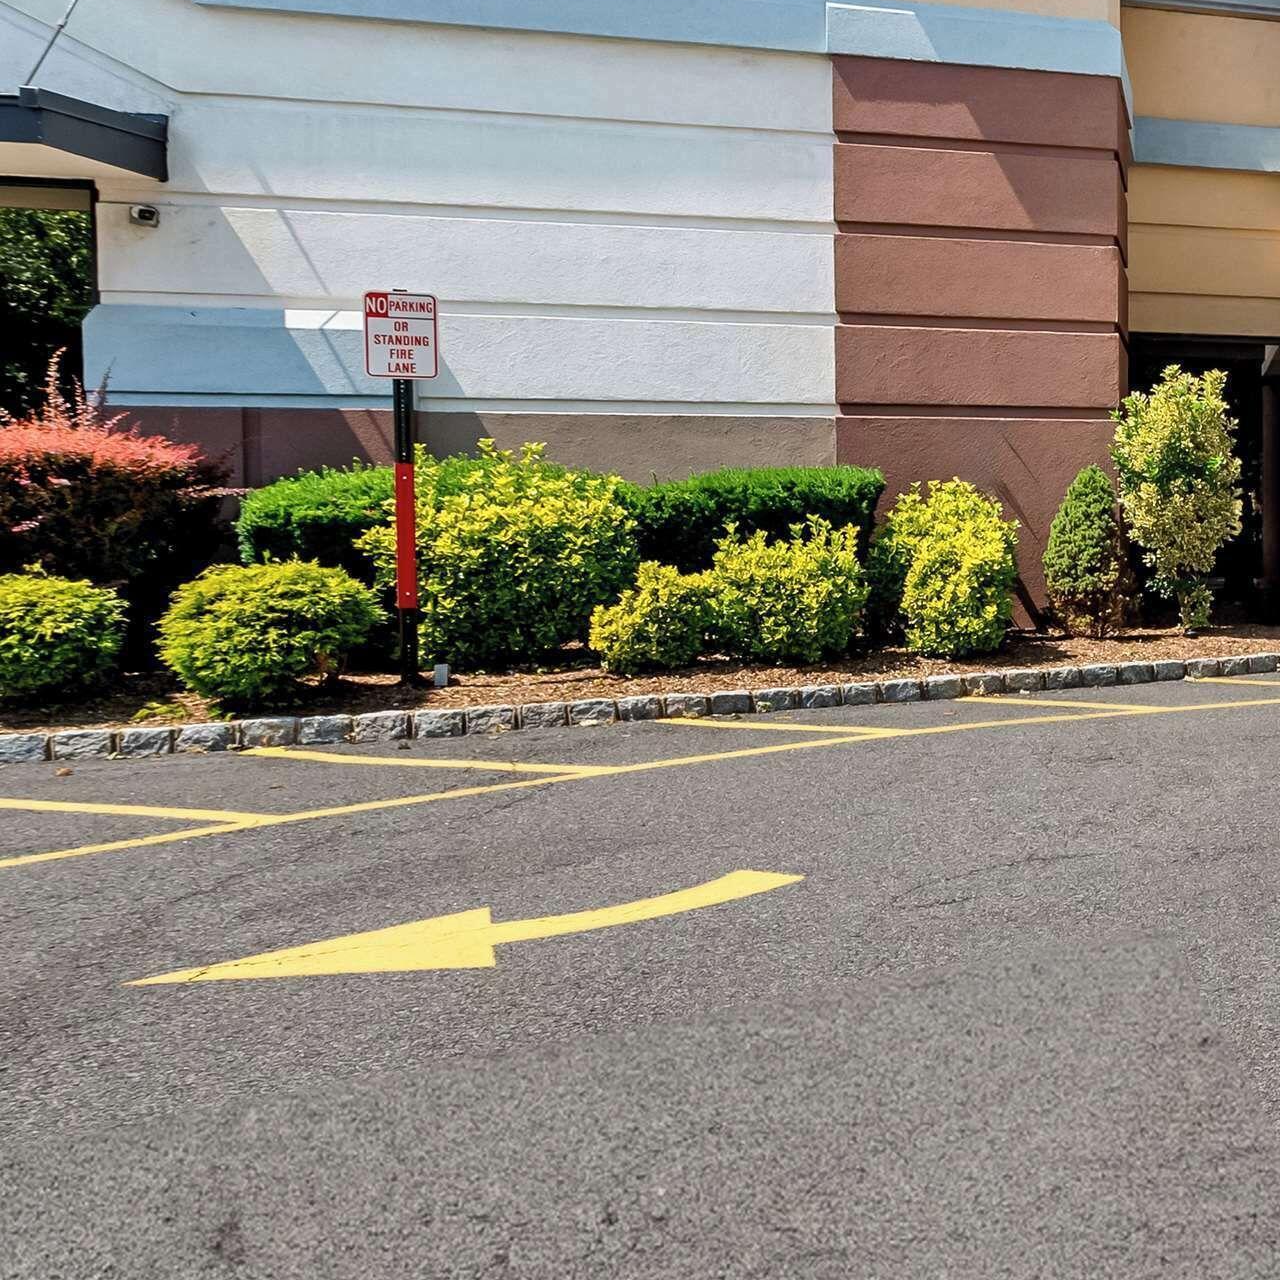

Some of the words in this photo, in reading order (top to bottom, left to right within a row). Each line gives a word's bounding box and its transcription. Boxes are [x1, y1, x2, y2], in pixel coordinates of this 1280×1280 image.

[366, 297, 387, 314] NO
[389, 300, 433, 313] PARKING
[394, 321, 409, 332] OR
[374, 334, 430, 346] STANDING
[390, 348, 414, 359] FIRE
[388, 362, 417, 373] LANE
